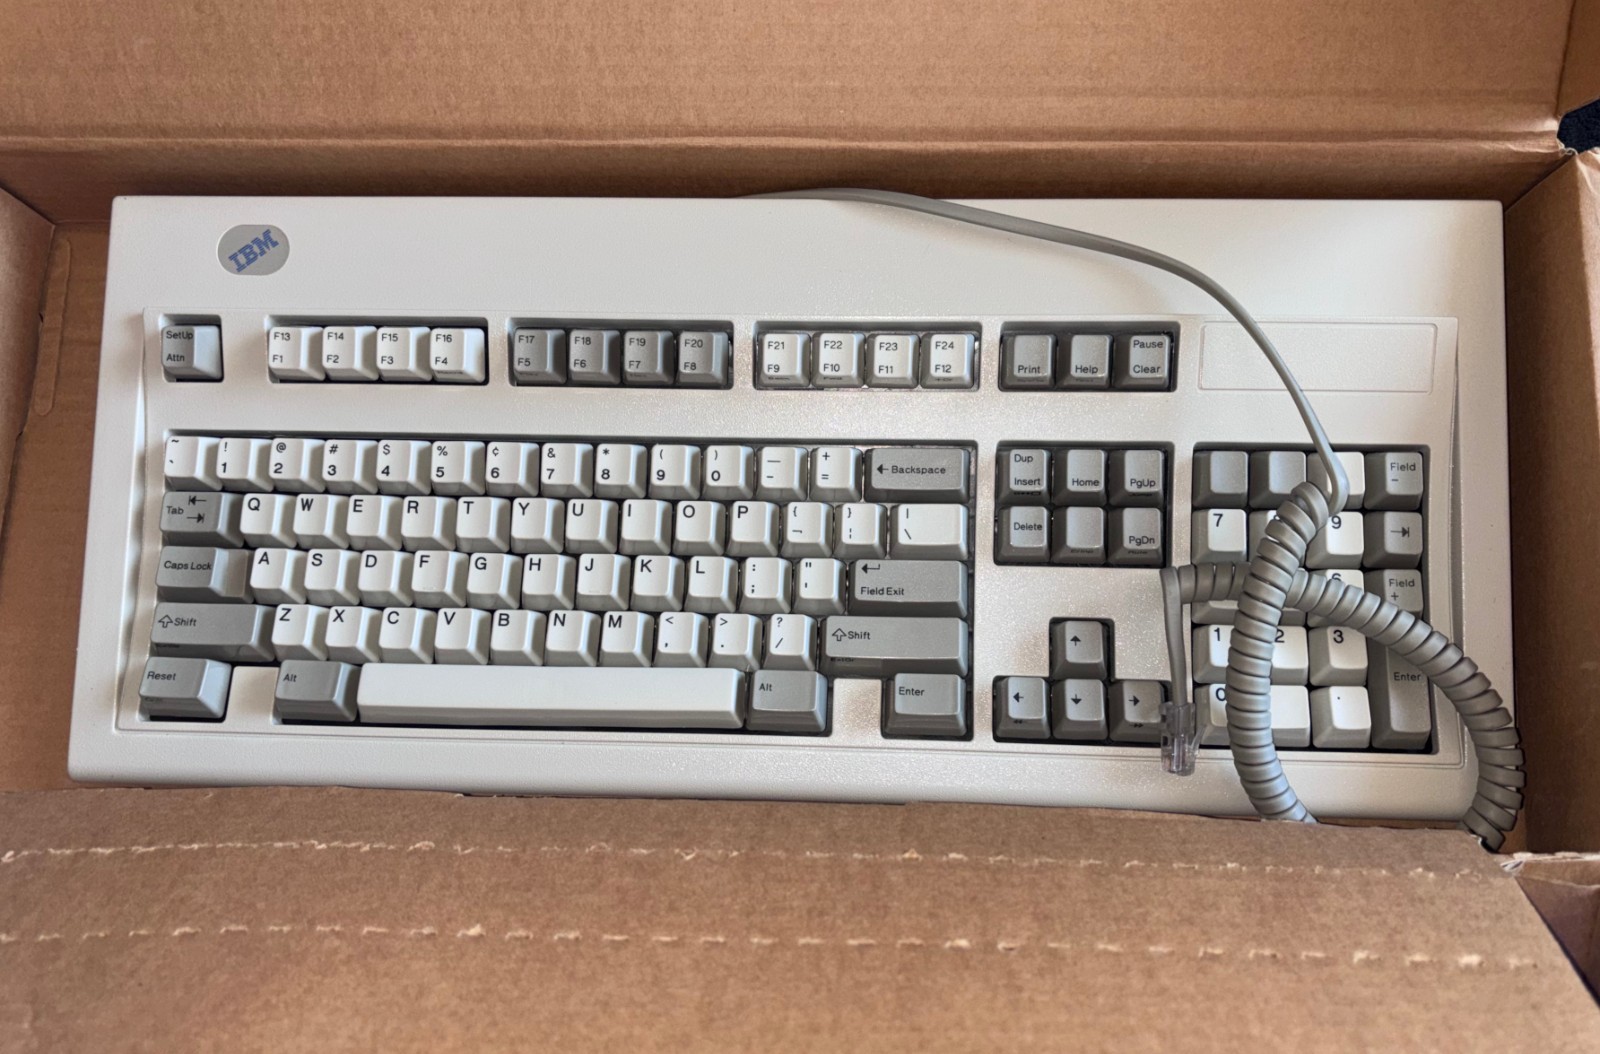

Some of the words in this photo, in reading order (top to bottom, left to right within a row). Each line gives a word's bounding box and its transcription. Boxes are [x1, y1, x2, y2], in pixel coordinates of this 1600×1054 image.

[228, 229, 279, 272] IBM
[166, 330, 193, 341] SetUp
[274, 332, 290, 341] F13
[327, 332, 344, 340] F14
[382, 333, 398, 342] F15
[436, 334, 452, 343] F16
[518, 335, 535, 343] F17
[574, 336, 591, 345] F18
[629, 338, 646, 346] F19
[685, 339, 703, 348] F20
[768, 341, 784, 350] F21
[824, 340, 843, 349] F22
[879, 342, 898, 351] F23
[935, 341, 954, 350] F24
[1133, 340, 1164, 348] Pause
[166, 353, 185, 361] Attn
[272, 354, 283, 363] F1
[327, 355, 339, 363] F2
[381, 356, 394, 365] F3
[435, 357, 448, 365] F4
[518, 357, 531, 366] F5
[574, 359, 586, 368] F6
[629, 360, 641, 369] F7
[684, 362, 696, 370] F8
[768, 364, 780, 373] F9
[824, 363, 840, 372] F10
[935, 364, 951, 373] F12
[879, 365, 893, 373] F11
[1018, 365, 1041, 374] Print
[1075, 365, 1098, 374] Help
[1133, 365, 1161, 373] Clear
[224, 442, 227, 452] !
[276, 442, 286, 453] @
[329, 444, 338, 454] #
[383, 444, 390, 455] $
[437, 446, 448, 456] %
[492, 447, 499, 456] ¢
[547, 448, 555, 458] &
[660, 449, 663, 459] (
[715, 450, 718, 460] )
[822, 452, 830, 460] +
[1014, 454, 1033, 463] Dup
[222, 462, 227, 473] 1
[274, 463, 283, 474] 2
[328, 465, 336, 476] 3
[381, 466, 390, 476] 4
[891, 465, 946, 475] Backspace
[1390, 462, 1416, 471] Field
[436, 467, 444, 478] 5
[491, 467, 499, 478] 6
[546, 468, 555, 480] 7
[601, 469, 610, 480] 8
[657, 469, 665, 481] 9
[711, 470, 720, 481] 0
[1014, 477, 1041, 486] Insert
[1072, 478, 1100, 486] Home
[1130, 478, 1156, 489] PgUp
[248, 497, 260, 511] Q
[301, 498, 313, 511] W
[353, 499, 363, 512] E
[407, 500, 419, 513] R
[463, 501, 474, 514] T
[519, 502, 530, 515] Y
[166, 506, 184, 515] Tab
[572, 503, 584, 516] U
[628, 504, 631, 517] I
[683, 505, 695, 518] O
[738, 505, 748, 518] P
[793, 506, 797, 517] {
[848, 507, 851, 518] }
[1213, 513, 1223, 527] 7
[1332, 515, 1342, 529] 9
[1014, 522, 1043, 531] Delete
[904, 529, 911, 540] \
[1129, 536, 1155, 546] PgDn
[258, 552, 269, 565] A
[312, 553, 323, 566] S
[365, 554, 377, 568] D
[419, 555, 430, 568] F
[475, 557, 487, 570] G
[164, 561, 188, 570] Caps
[190, 562, 212, 570] Lock
[529, 558, 541, 571] H
[585, 558, 594, 571] J
[641, 559, 652, 572] K
[696, 560, 705, 574] L
[1389, 579, 1415, 587] Field
[751, 585, 755, 593] ;
[861, 587, 884, 595] Field
[886, 587, 904, 595] Exit
[1391, 592, 1399, 601] +
[279, 608, 291, 621] Z
[333, 609, 345, 622] X
[387, 611, 399, 624] C
[444, 612, 456, 625] V
[498, 613, 509, 626] B
[554, 613, 566, 626] N
[174, 617, 197, 626] Shift
[608, 615, 622, 628] M
[720, 618, 728, 626] >
[777, 617, 783, 627] ?
[848, 631, 870, 640] Shift
[1214, 628, 1220, 641] 1
[1274, 629, 1285, 643] 2
[1333, 630, 1344, 644] 3
[775, 638, 783, 648] /
[147, 671, 176, 680] Reset
[283, 673, 297, 682] Alt
[1394, 672, 1421, 681] Enter
[759, 683, 772, 691] Alt
[899, 686, 925, 696] Enter
